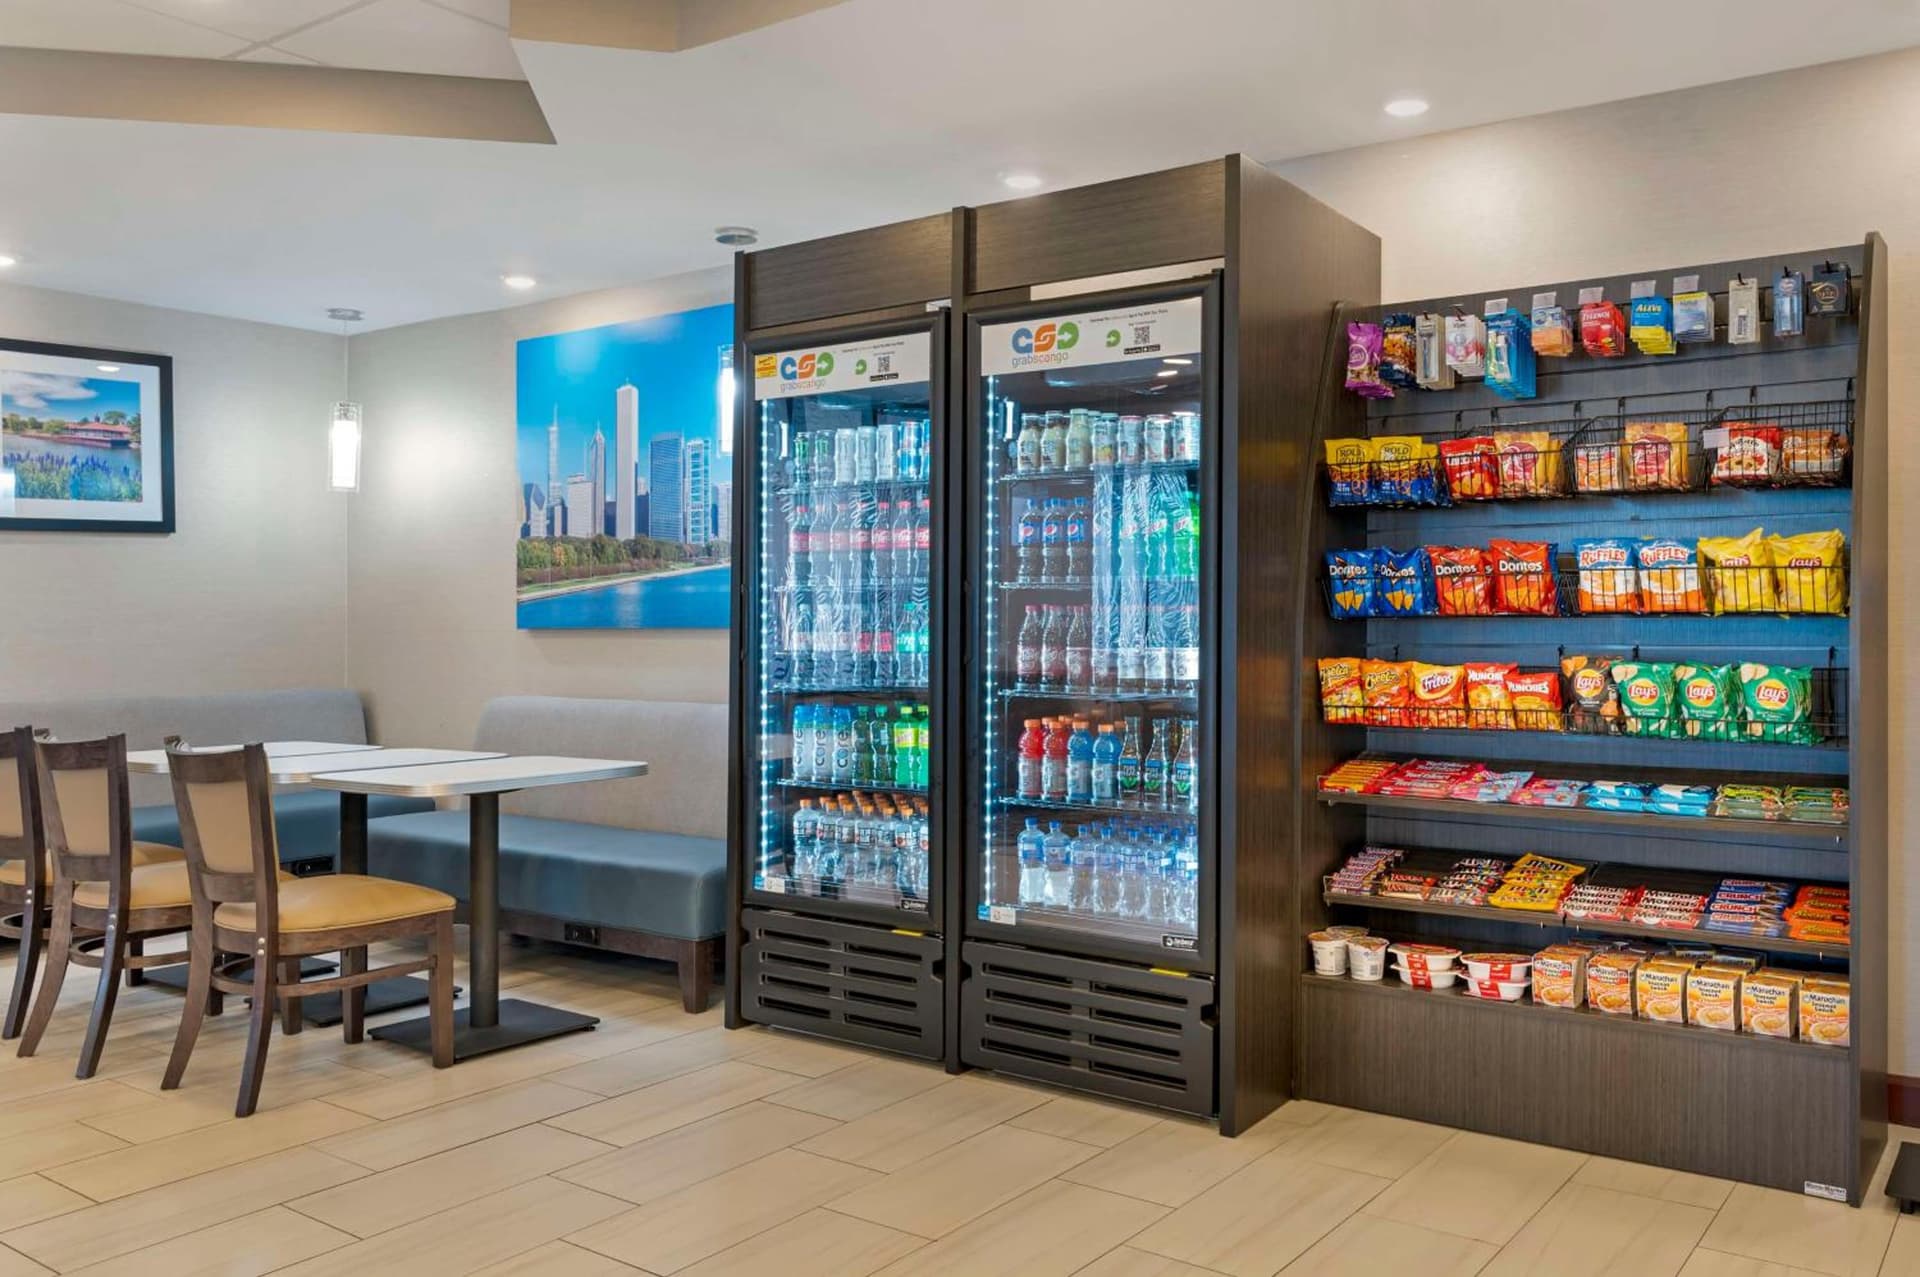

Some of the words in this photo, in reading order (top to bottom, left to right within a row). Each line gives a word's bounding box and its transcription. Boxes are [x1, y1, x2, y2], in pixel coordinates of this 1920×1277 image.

[1581, 549, 1625, 566] RUFFLES
[1641, 547, 1687, 567] RUFFLES
[1329, 564, 1368, 578] Doritos
[1435, 564, 1478, 576] Doritos
[1499, 560, 1543, 573] Doritos
[1422, 673, 1453, 692] Fritos
[815, 729, 826, 766] core
[836, 730, 849, 768] core
[1711, 903, 1757, 913] CRUNCH
[1696, 979, 1730, 989] Maruchan
[1751, 986, 1785, 996] Maruchan
[1809, 993, 1846, 1004] Maruchan
